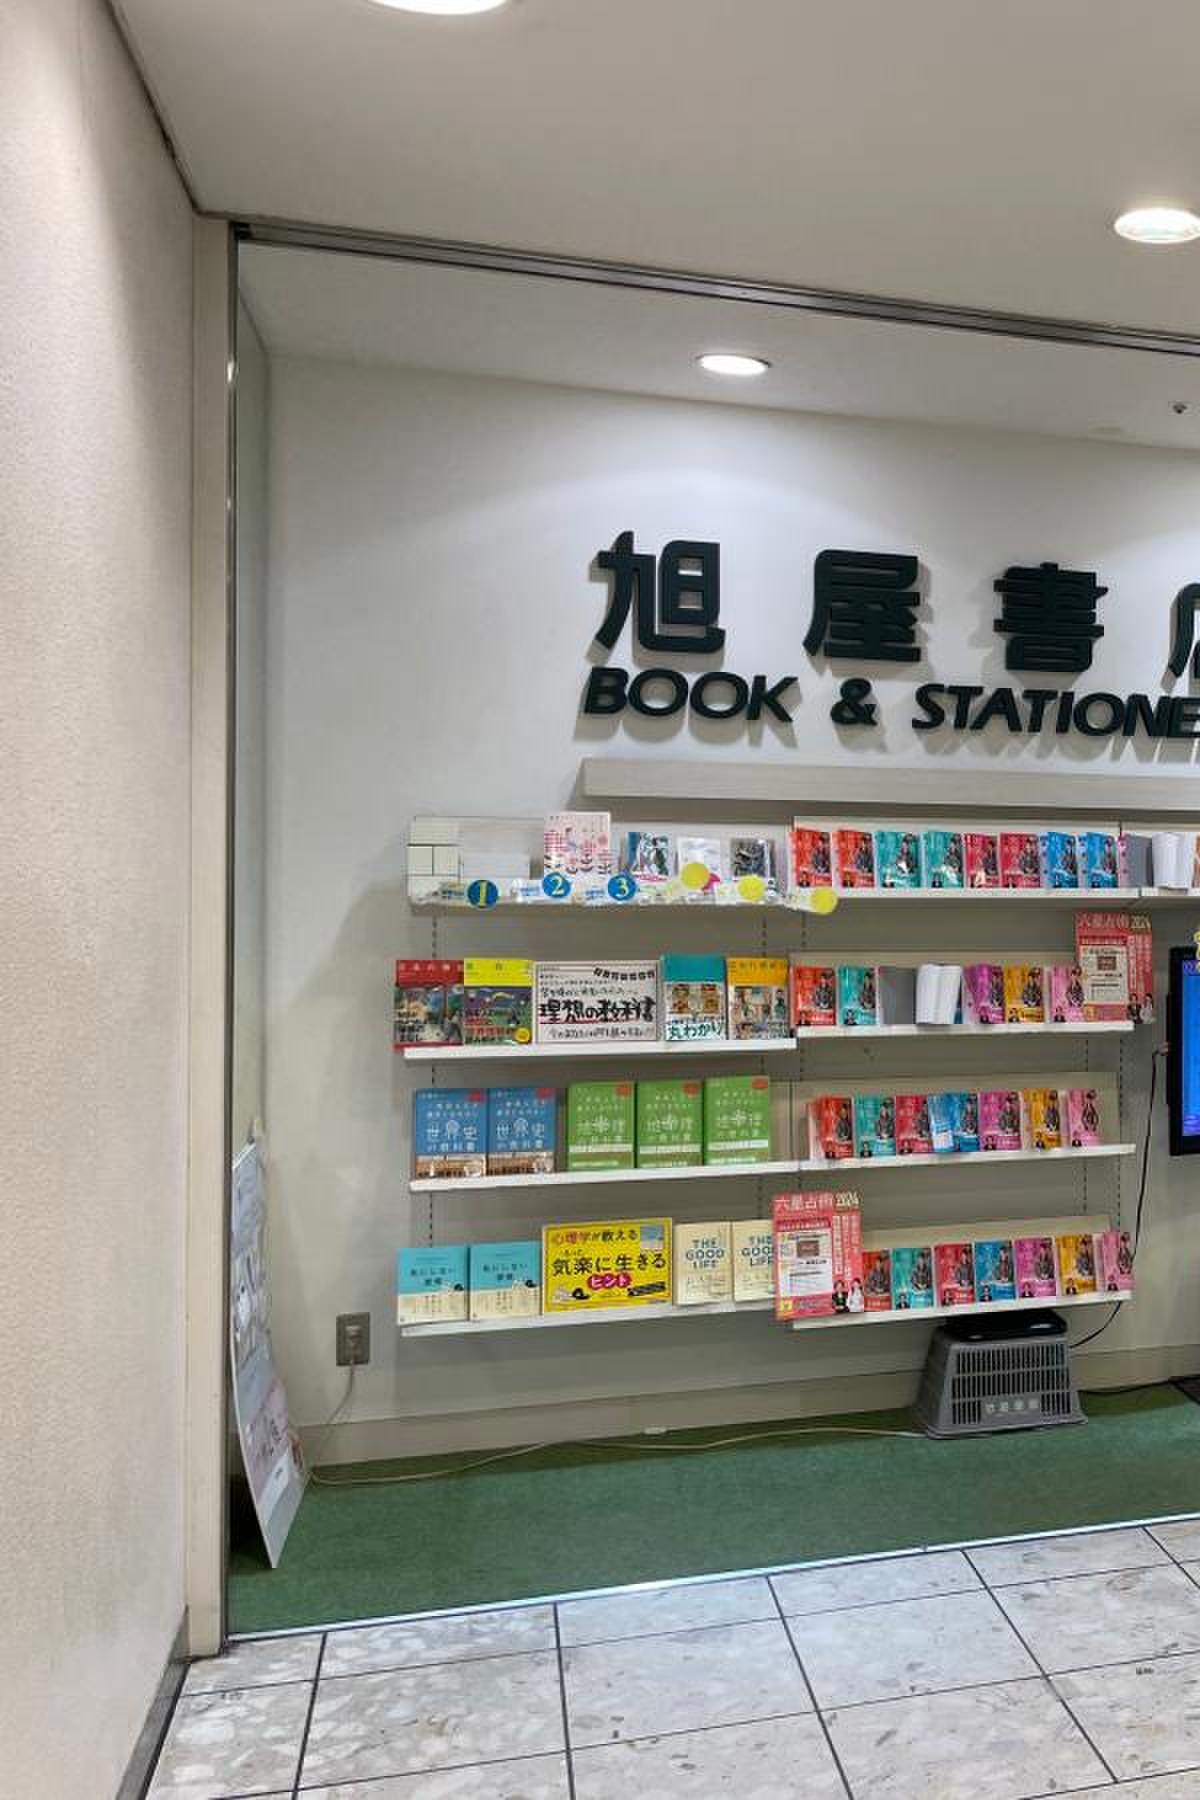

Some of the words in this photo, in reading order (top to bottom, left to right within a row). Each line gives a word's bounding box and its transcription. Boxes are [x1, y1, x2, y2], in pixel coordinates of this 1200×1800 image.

[584, 666, 798, 722] BOOK
[830, 678, 878, 727] &
[551, 875, 564, 895] 2
[618, 881, 630, 898] 3
[539, 996, 656, 1023] 理想の教科書
[692, 1238, 718, 1249] THE
[685, 1249, 725, 1260] GOOD
[741, 1247, 774, 1258] GOO
[552, 1252, 667, 1277] 気楽に生きる
[693, 1260, 718, 1271] LIFE
[590, 1275, 630, 1290] ヒント
